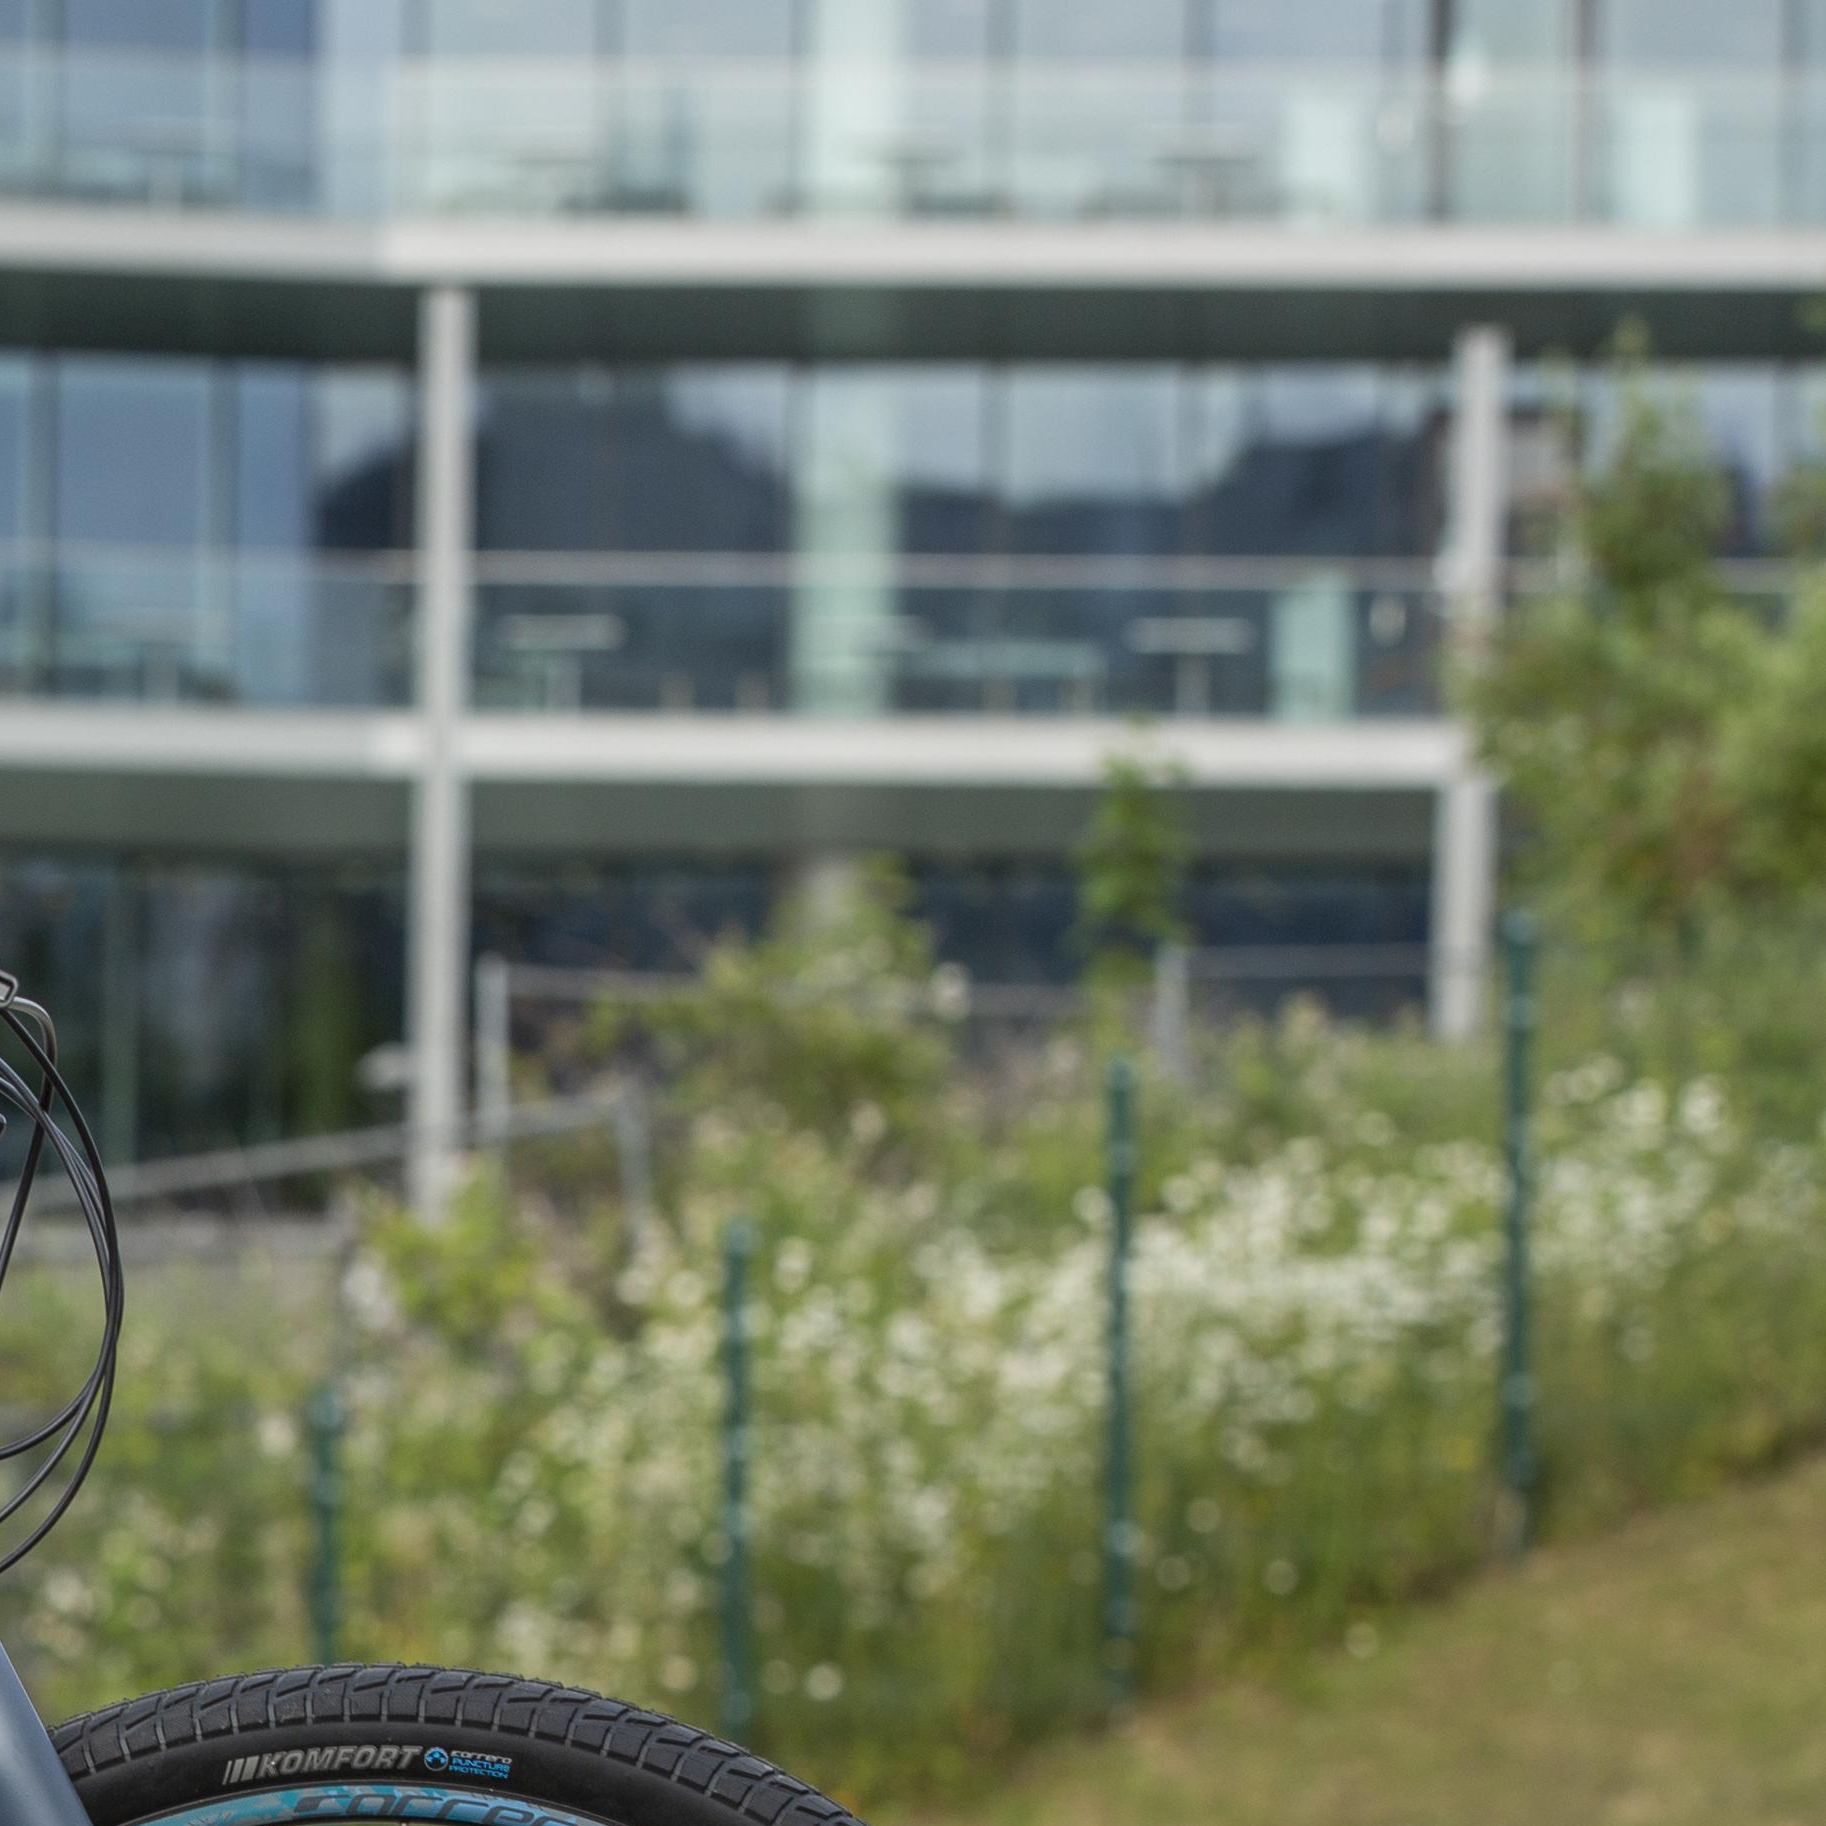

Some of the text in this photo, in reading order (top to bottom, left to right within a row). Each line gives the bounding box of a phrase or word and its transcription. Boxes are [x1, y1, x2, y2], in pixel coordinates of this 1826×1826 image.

[255, 1745, 424, 1778] KOMFORT
[450, 1750, 512, 1765] carrera
[452, 1757, 511, 1773] PUNCTURE
[448, 1764, 509, 1780] PROTECTION
